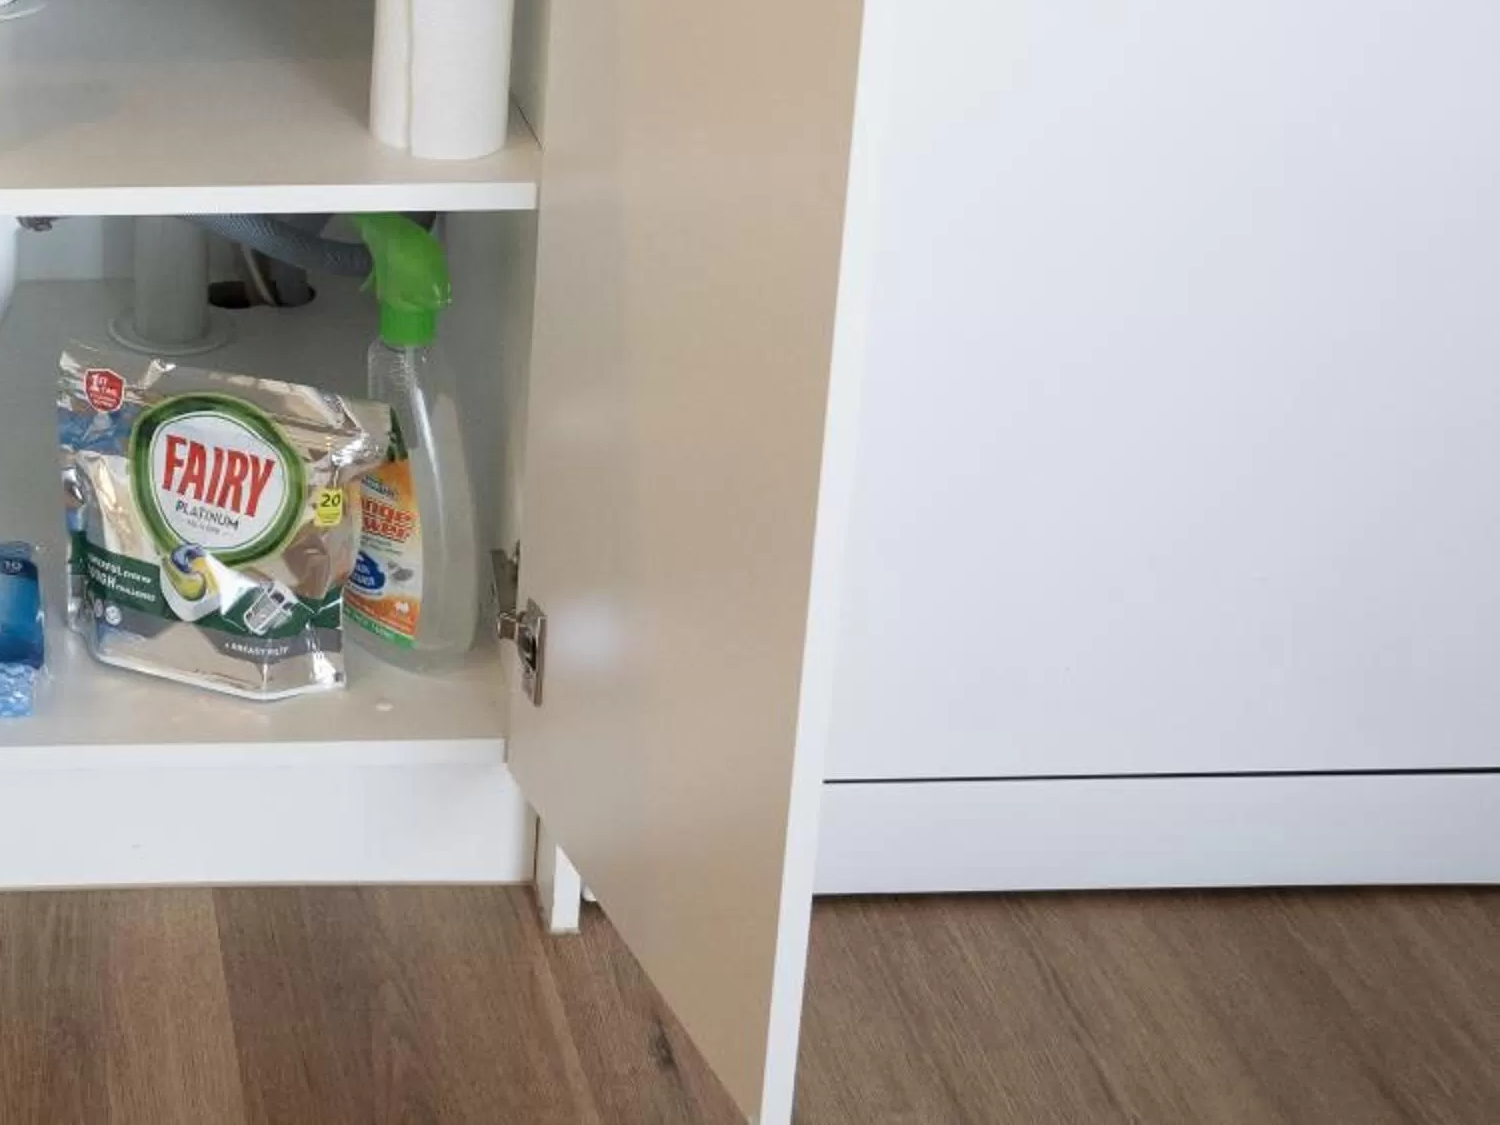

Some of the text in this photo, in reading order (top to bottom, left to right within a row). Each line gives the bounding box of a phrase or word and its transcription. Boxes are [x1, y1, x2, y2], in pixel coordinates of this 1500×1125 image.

[162, 435, 276, 518] FAIRY
[176, 500, 240, 531] PLATINUM
[320, 493, 341, 508] 20
